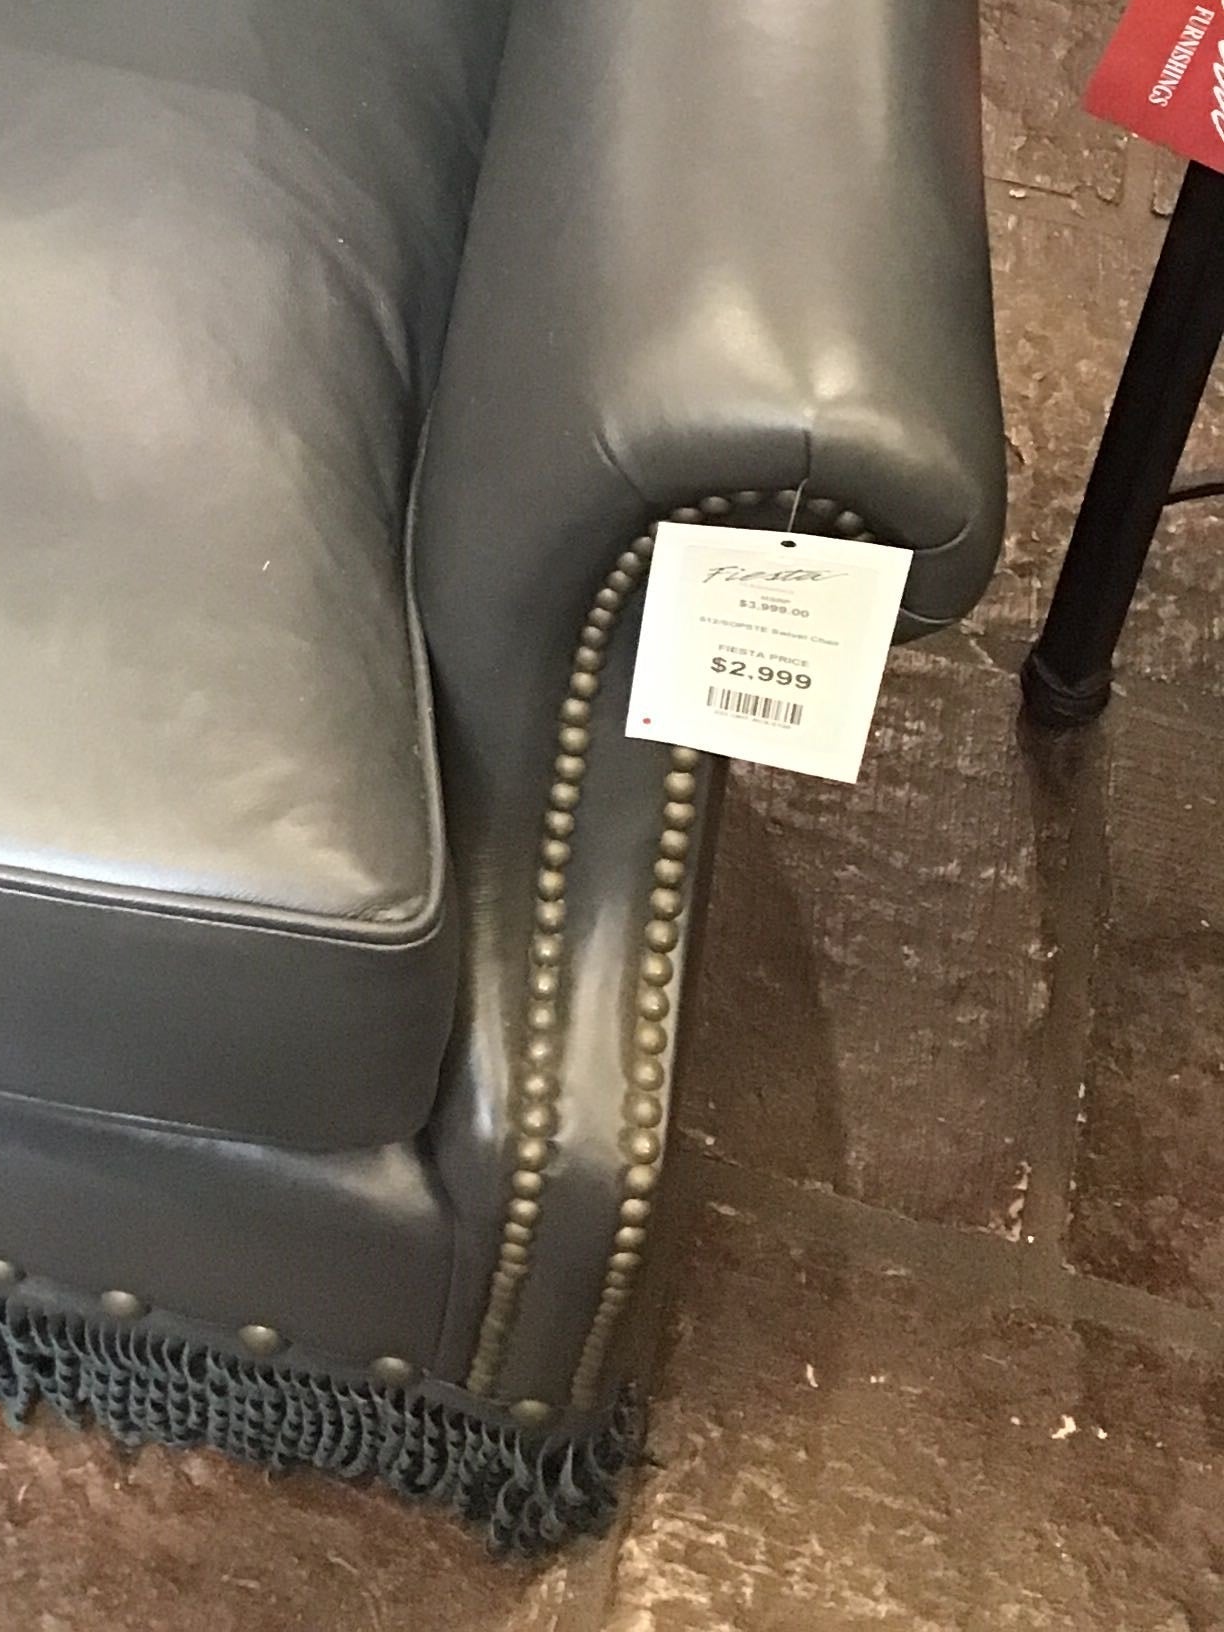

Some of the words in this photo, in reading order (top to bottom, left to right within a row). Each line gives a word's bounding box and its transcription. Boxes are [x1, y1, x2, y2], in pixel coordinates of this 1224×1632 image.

[1148, 5, 1215, 107] FURNISHINGS
[702, 565, 849, 584] Fiesta
[718, 643, 766, 659] FIESTA
[769, 653, 809, 667] PRICE
